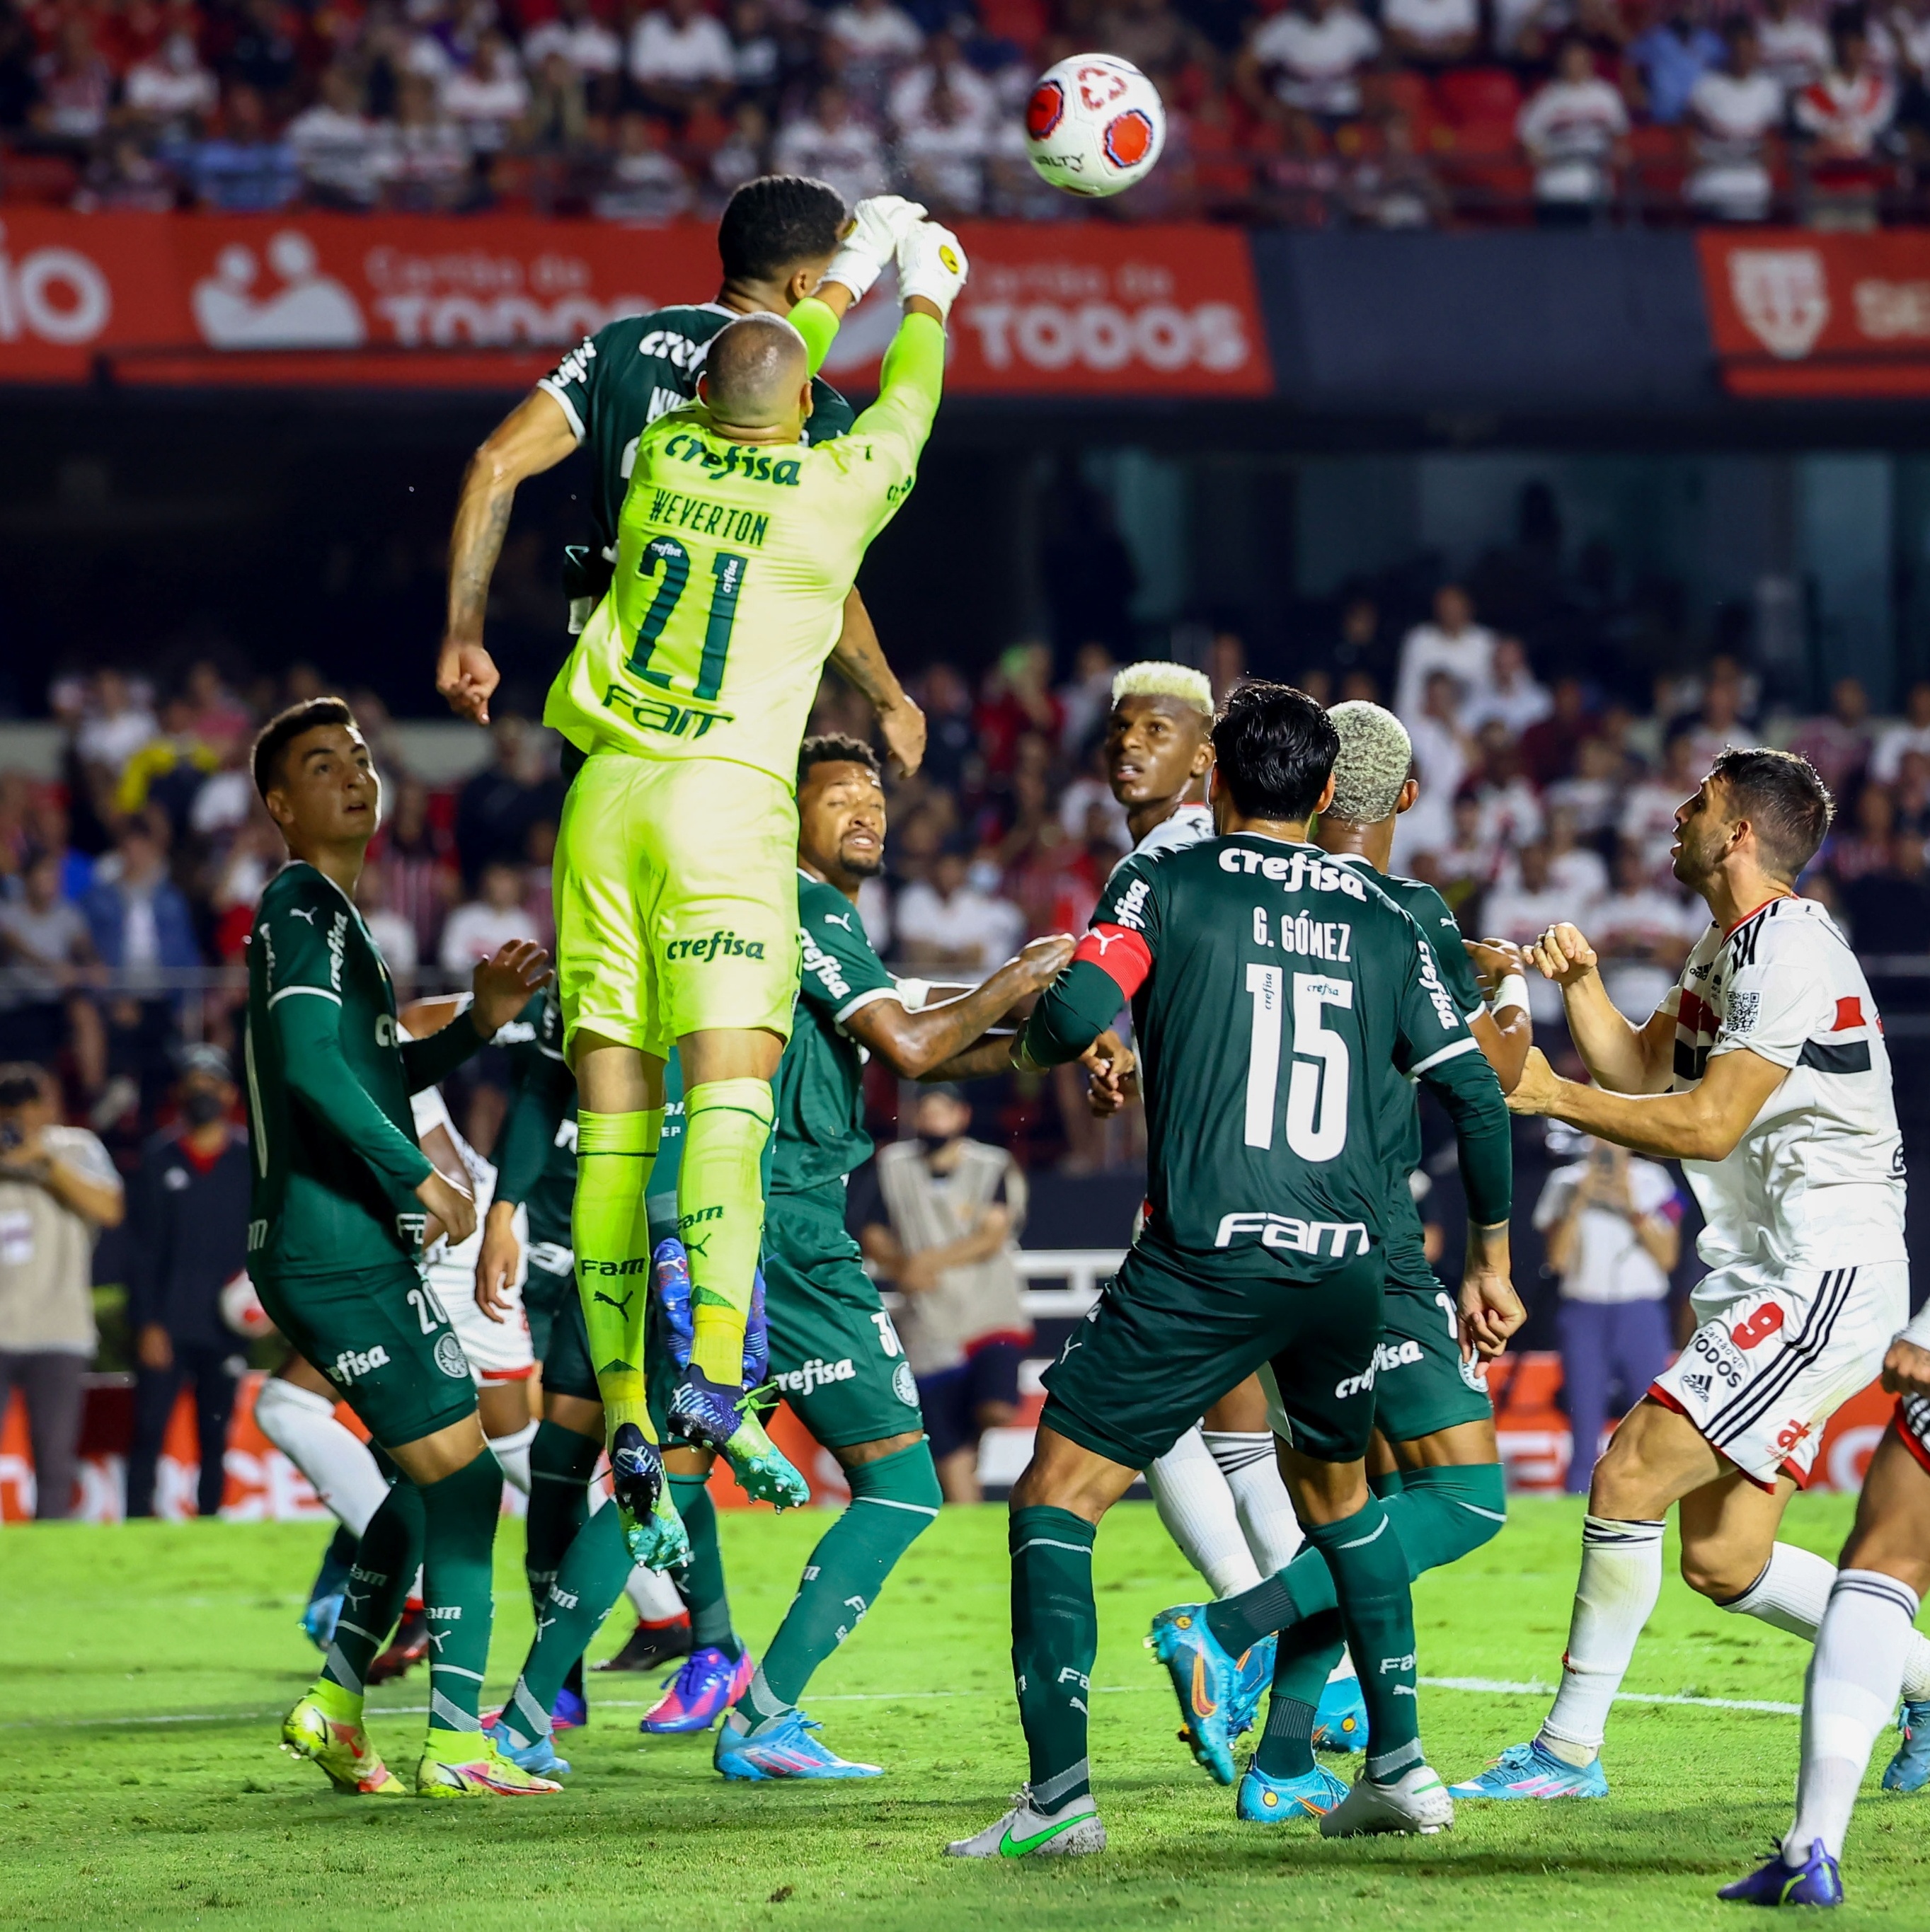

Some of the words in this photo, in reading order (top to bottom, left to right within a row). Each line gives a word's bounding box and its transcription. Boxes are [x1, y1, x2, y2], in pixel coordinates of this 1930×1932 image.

[665, 435, 801, 485] crefisa
[649, 488, 769, 547] WEVERTON
[625, 536, 747, 701] 21
[1219, 848, 1367, 902] crefisa
[667, 931, 764, 962] crefisa
[1253, 907, 1274, 948] G.
[1280, 909, 1351, 962] GÓMEZ
[1264, 972, 1273, 1010] crefisa
[1418, 940, 1459, 1030] crefisa
[1244, 963, 1353, 1162] 15
[407, 1281, 449, 1335] 20
[1731, 1301, 1784, 1350] 9
